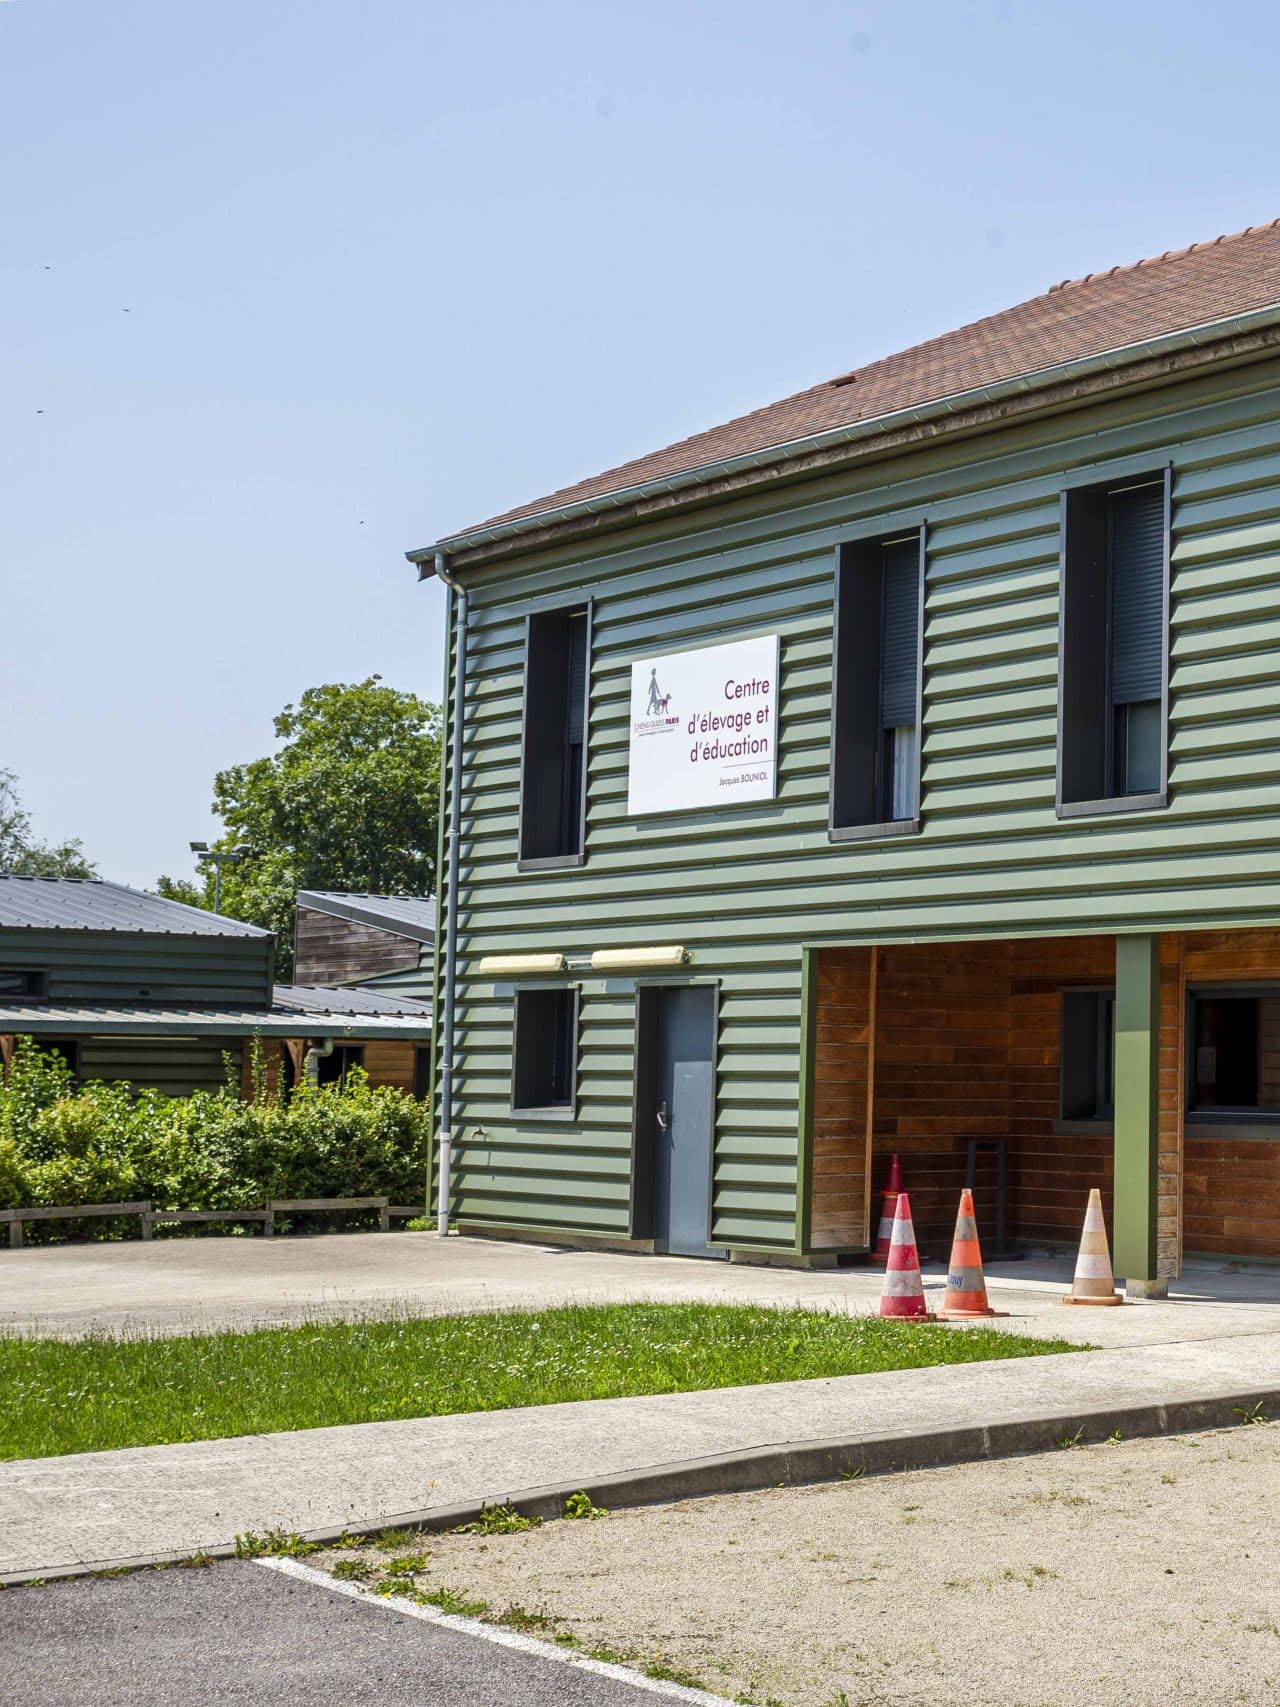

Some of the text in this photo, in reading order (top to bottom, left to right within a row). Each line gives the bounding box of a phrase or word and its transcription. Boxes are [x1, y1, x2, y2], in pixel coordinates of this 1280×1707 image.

[724, 678, 770, 700] Centre
[665, 716, 680, 725] PARIS
[688, 711, 752, 735] d'élevage
[756, 705, 770, 724] et
[690, 735, 768, 763] d'éducation
[719, 771, 768, 787] Jacques BOUNIOL
